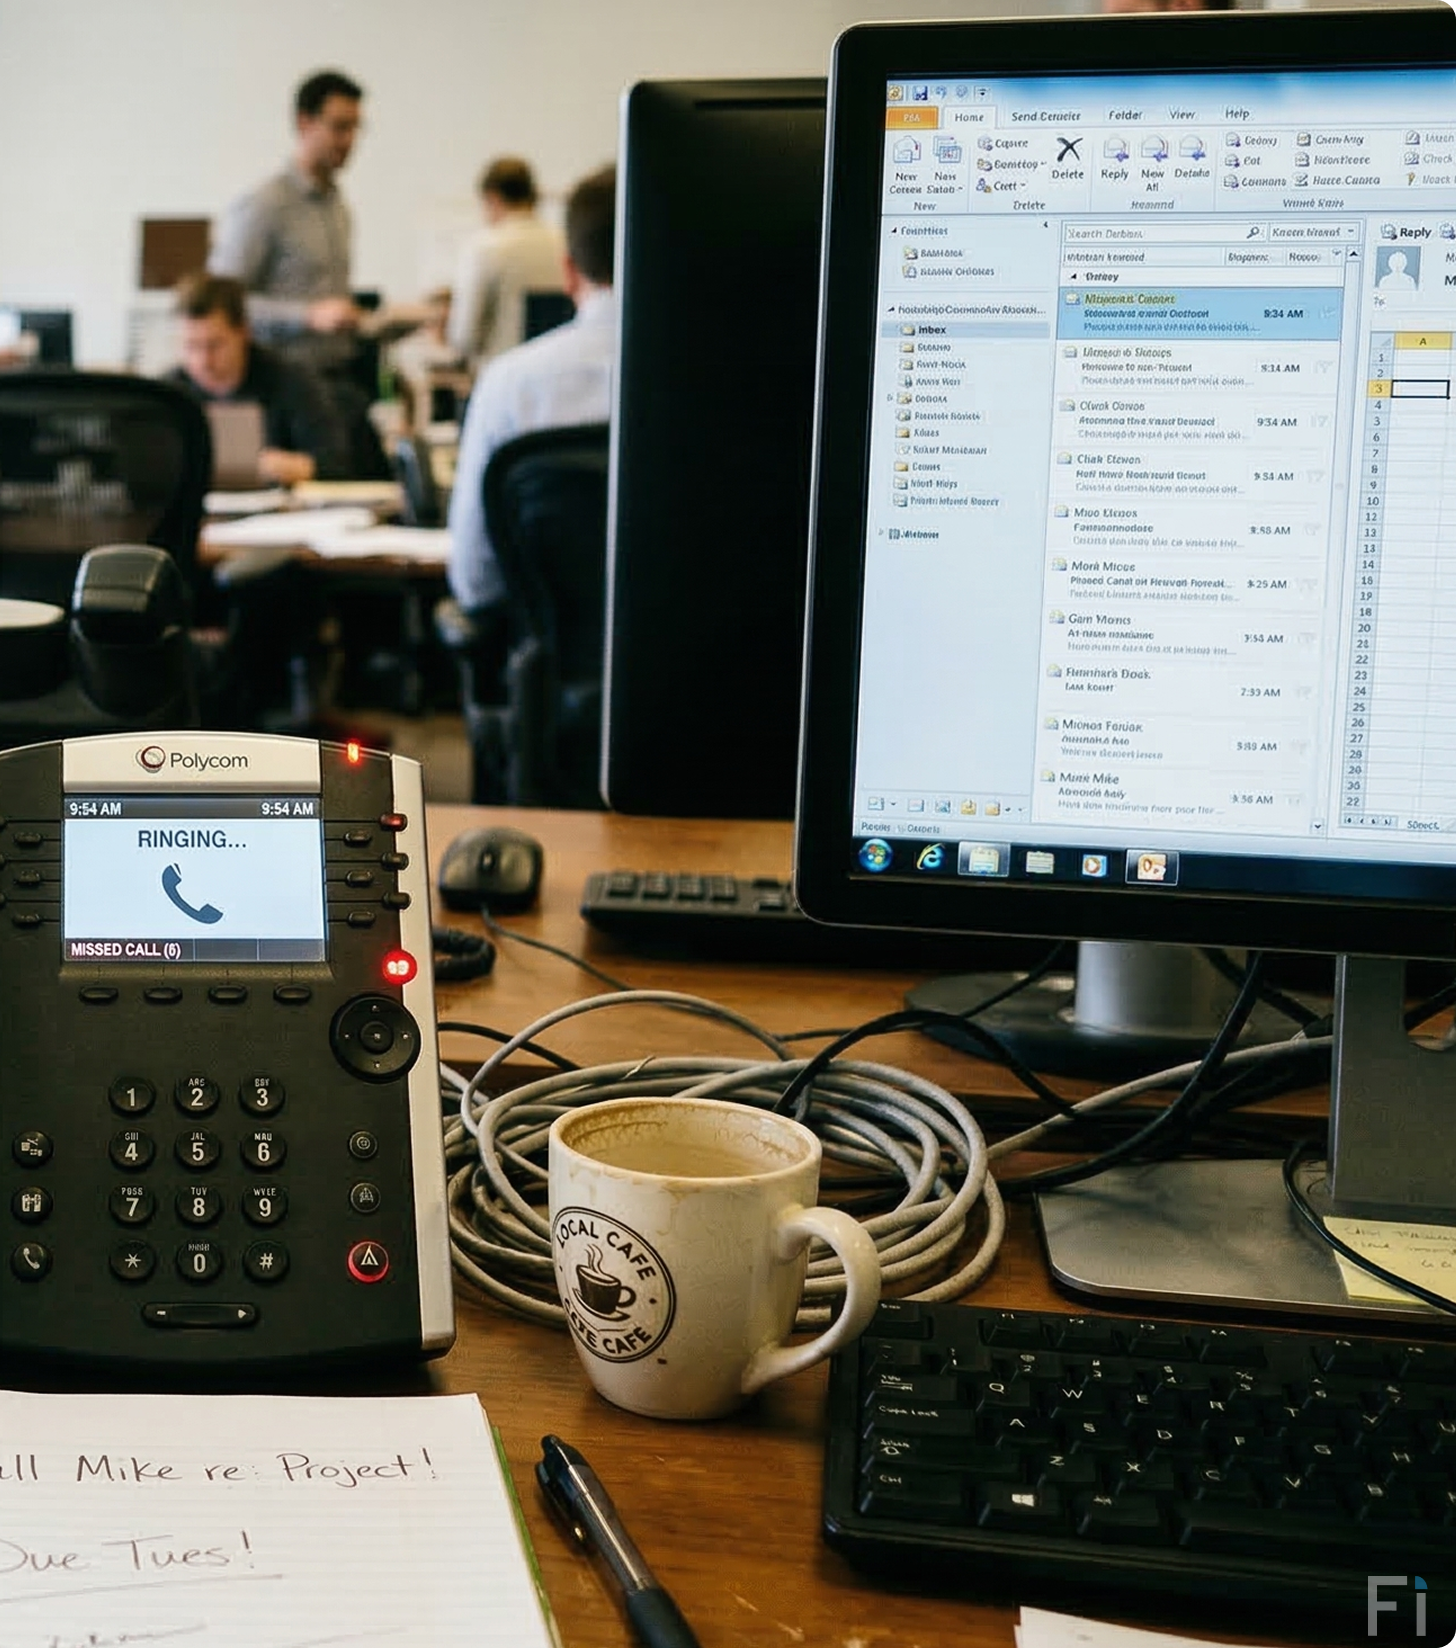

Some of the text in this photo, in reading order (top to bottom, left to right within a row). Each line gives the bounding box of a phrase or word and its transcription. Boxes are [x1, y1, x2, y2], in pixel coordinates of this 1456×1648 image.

[955, 113, 984, 123] Home
[1011, 111, 1038, 122] Send
[1225, 107, 1250, 121] Help
[1051, 169, 1084, 180] Delete
[1400, 227, 1432, 241] Reply
[1287, 309, 1304, 319] AM
[1419, 336, 1427, 346] A
[1284, 363, 1301, 373] AM
[1377, 369, 1384, 378] 2
[1376, 384, 1383, 394] 3
[1375, 400, 1382, 410] 4
[1280, 417, 1297, 427] AM
[1373, 432, 1380, 442] 6
[1372, 449, 1380, 458] 7
[1277, 471, 1294, 482] AM
[1274, 526, 1291, 536] AM
[1362, 560, 1374, 570] 14
[1270, 579, 1287, 589] AM
[1357, 623, 1371, 633] 20
[1267, 634, 1284, 644] AM
[1355, 655, 1368, 665] 22
[1354, 670, 1368, 681] 23
[1263, 688, 1281, 698] AM
[1353, 686, 1367, 696] 24
[1352, 702, 1366, 712] 25
[1349, 733, 1363, 743] 27
[1260, 742, 1278, 752] AM
[170, 752, 249, 771] Polycom
[1256, 795, 1274, 805] AM
[99, 802, 122, 816] AM
[292, 802, 314, 816] AM
[137, 830, 247, 849] RINGING...
[71, 942, 123, 957] MISSED
[124, 942, 162, 957] CALL
[126, 1087, 136, 1107] 1
[191, 1087, 204, 1107] 2
[256, 1087, 269, 1107] 3
[124, 1142, 139, 1161] 4
[192, 1142, 205, 1162] 5
[257, 1142, 271, 1162] 6
[190, 1186, 208, 1196] TUV
[125, 1197, 140, 1217] 7
[193, 1197, 206, 1217] 8
[258, 1197, 272, 1218] 9
[556, 1219, 657, 1281] LOCAL CAFE
[194, 1253, 207, 1273] 0
[602, 1326, 653, 1354] CAFE
[1062, 1388, 1084, 1399] W
[76, 1454, 184, 1483] Mike
[205, 1460, 260, 1484] re:
[277, 1447, 441, 1488] Project!
[1126, 1461, 1141, 1473] X
[101, 1529, 256, 1572] Tues!
